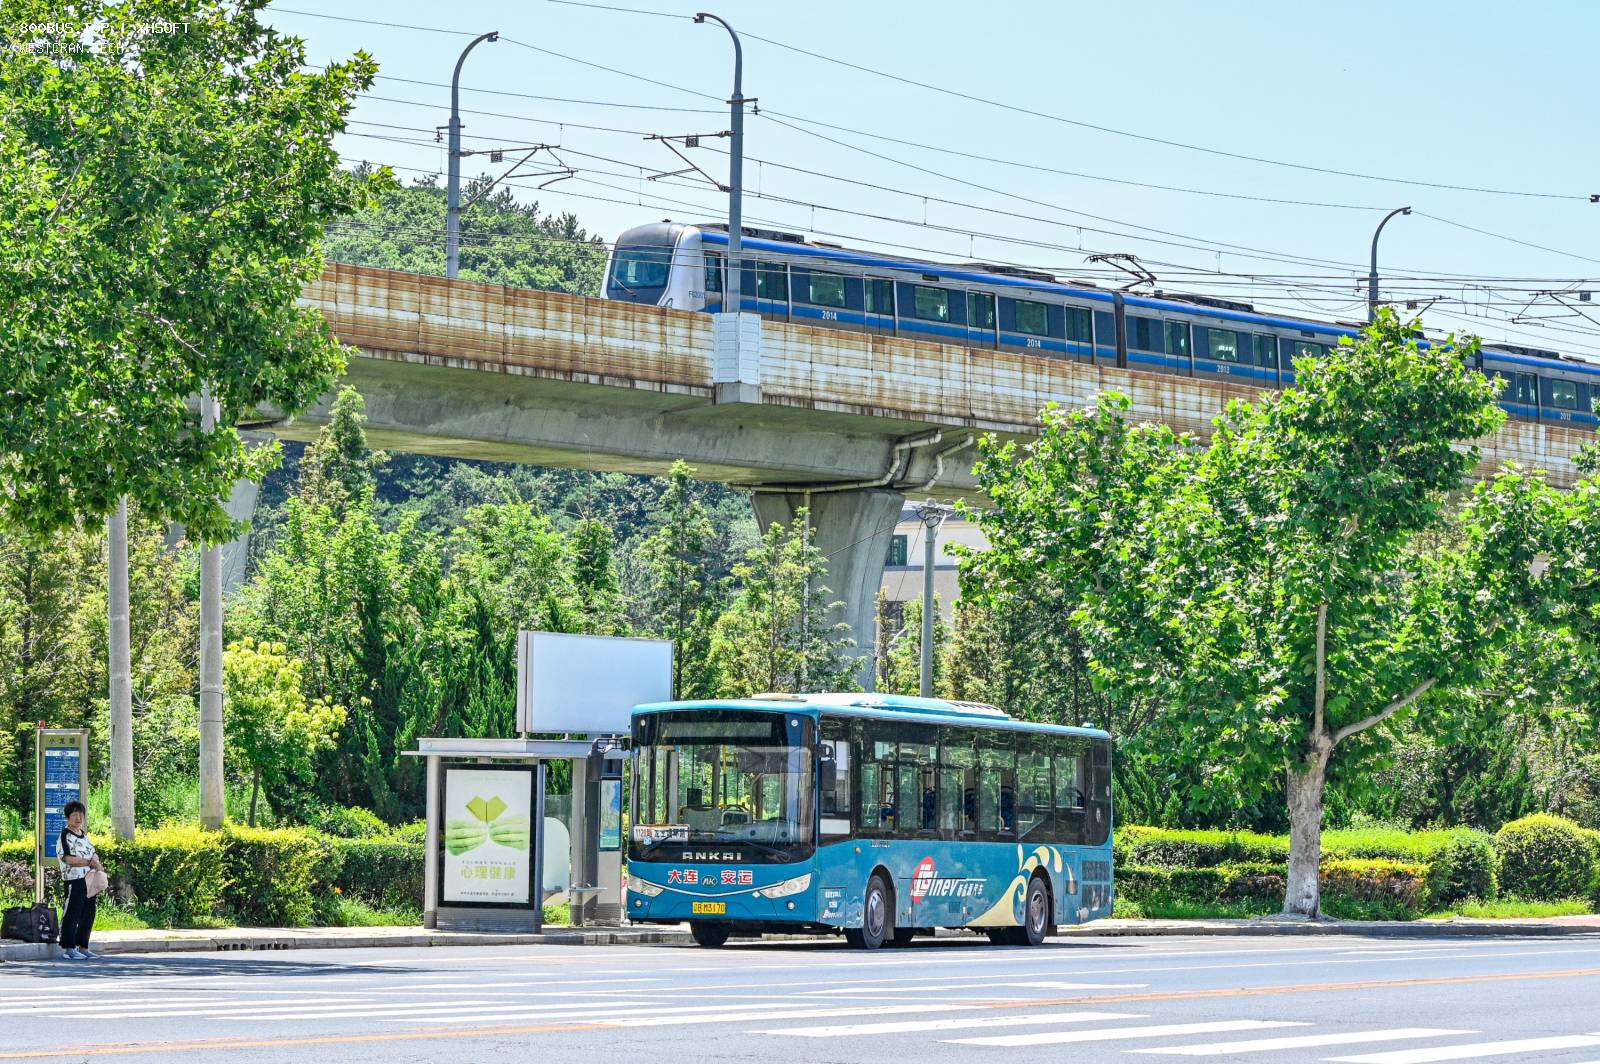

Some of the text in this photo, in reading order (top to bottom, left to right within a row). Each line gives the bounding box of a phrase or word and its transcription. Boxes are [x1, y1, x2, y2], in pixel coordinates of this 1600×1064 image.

[822, 310, 837, 320] 2014
[1027, 338, 1041, 348] 2014
[682, 852, 742, 860] ANKAI
[460, 865, 517, 880] 心理健康
[668, 869, 698, 884] 大连
[721, 870, 753, 885] 交运
